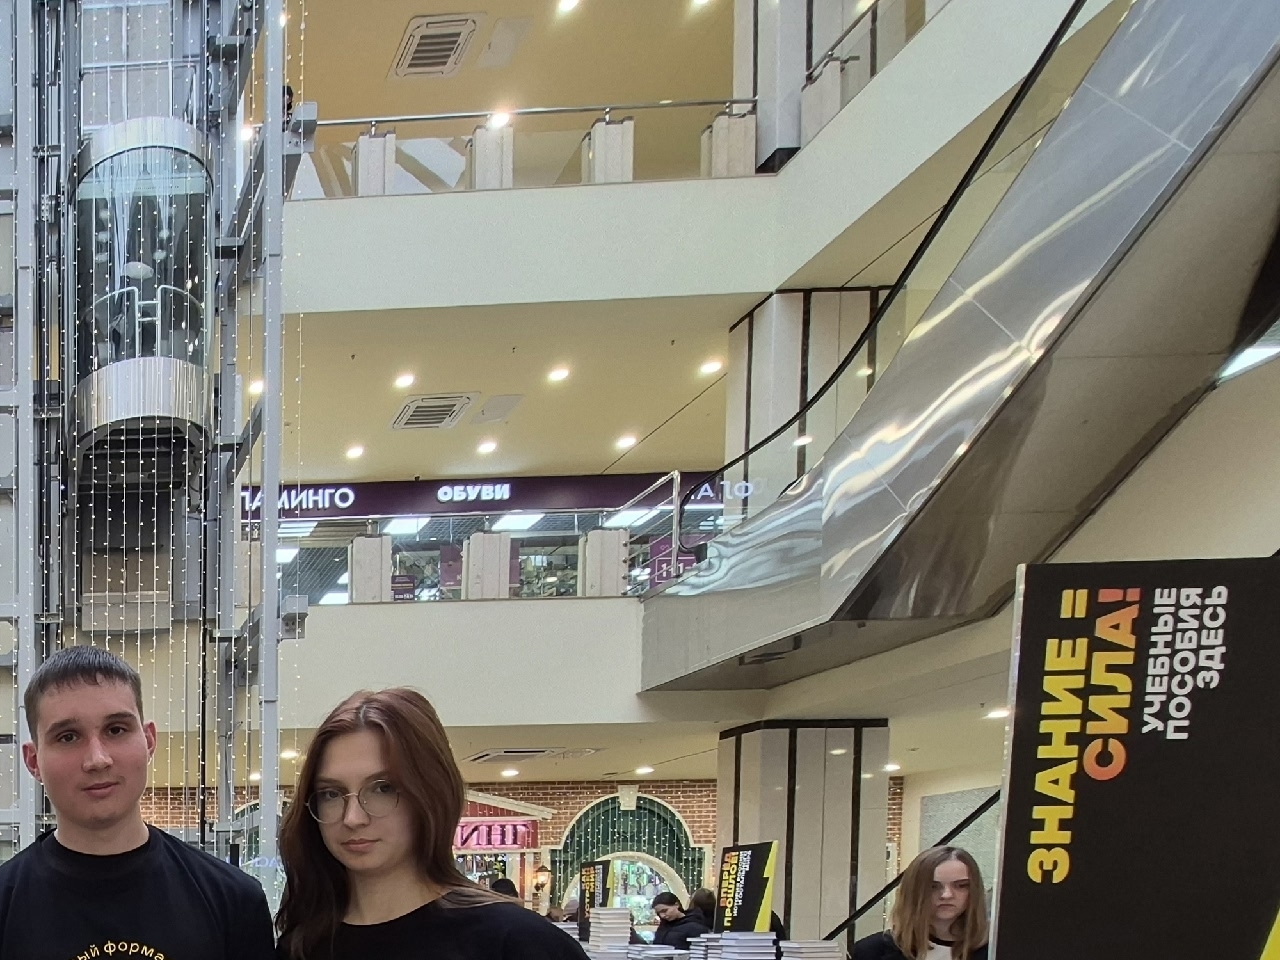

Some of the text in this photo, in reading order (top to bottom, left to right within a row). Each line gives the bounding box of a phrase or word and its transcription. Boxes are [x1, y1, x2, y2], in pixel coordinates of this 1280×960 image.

[437, 484, 510, 502] ОБУВИ
[1082, 587, 1141, 781] СИЛА!
[1140, 587, 1177, 735] УЧЕБНЫЕ
[1165, 587, 1204, 740] ПОСОБИЯ
[1196, 585, 1229, 689] ЗДЕСЬ
[1027, 637, 1089, 884] ЗНАНИЕ
